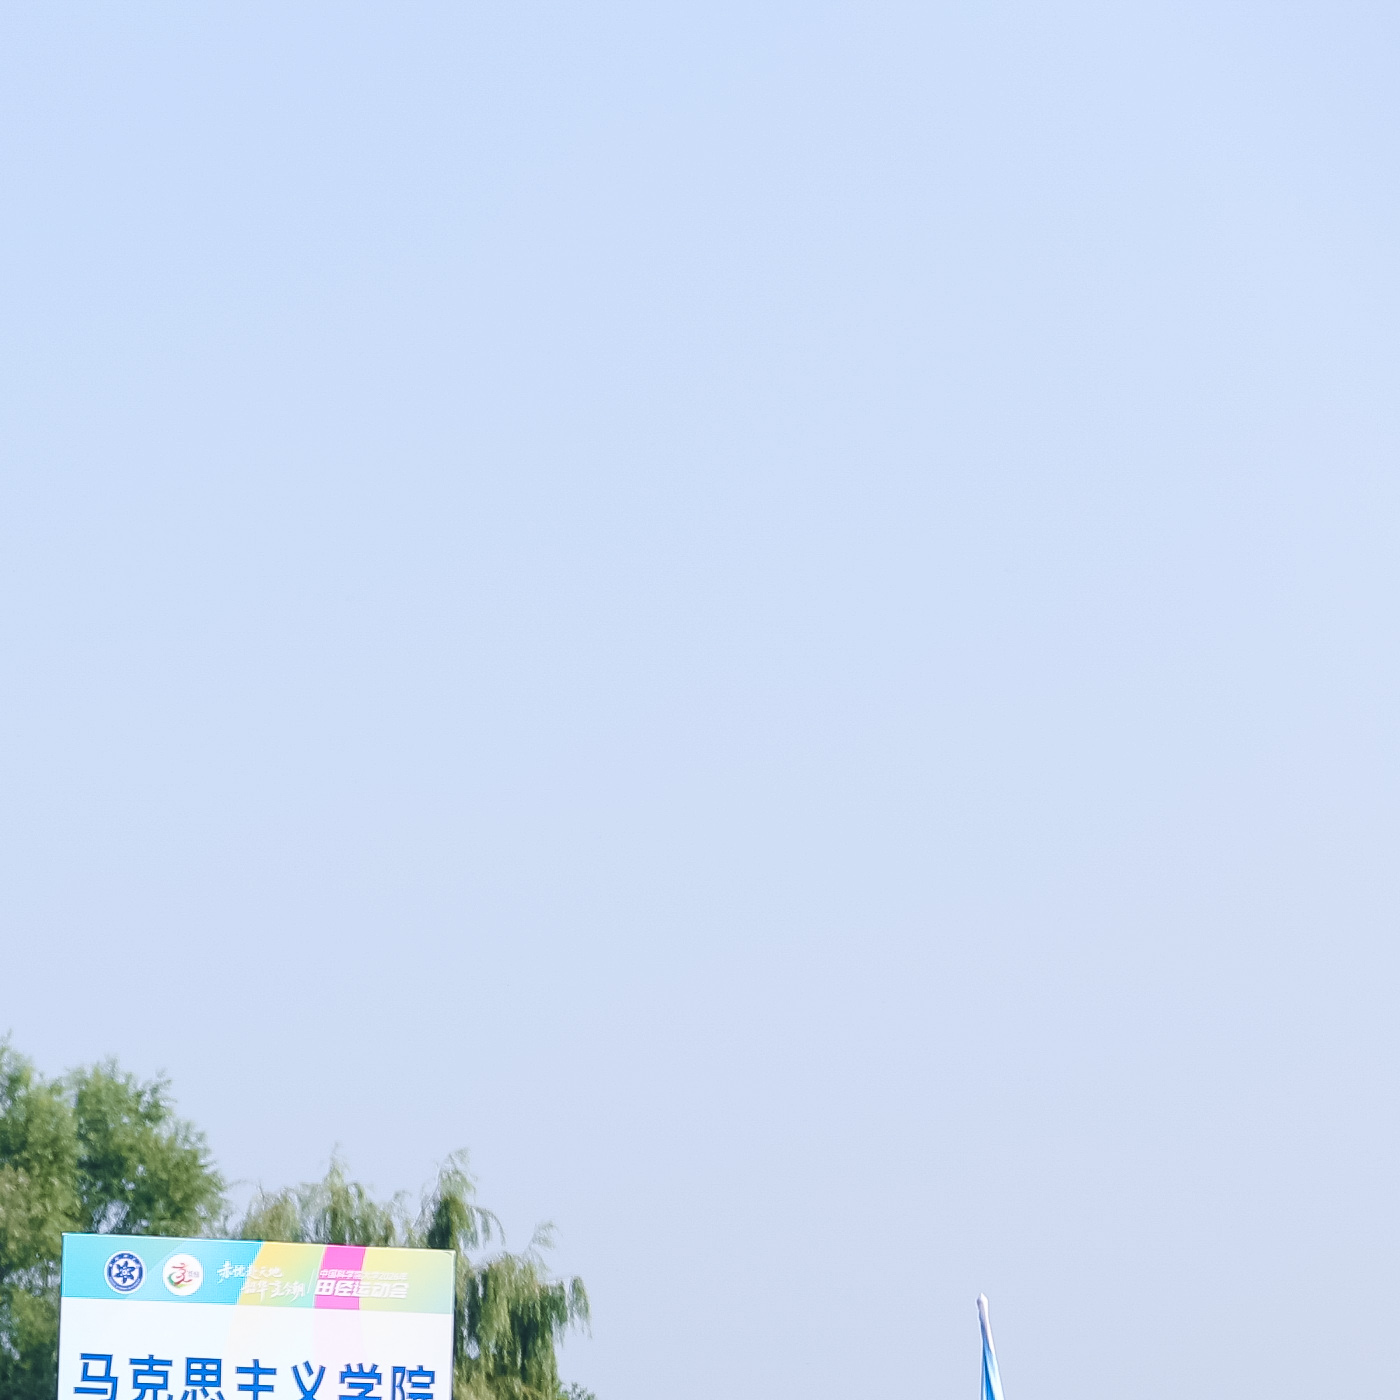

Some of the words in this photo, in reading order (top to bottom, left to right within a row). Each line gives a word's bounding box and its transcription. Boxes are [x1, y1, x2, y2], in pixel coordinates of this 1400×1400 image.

[314, 1279, 410, 1299] 田径运动会
